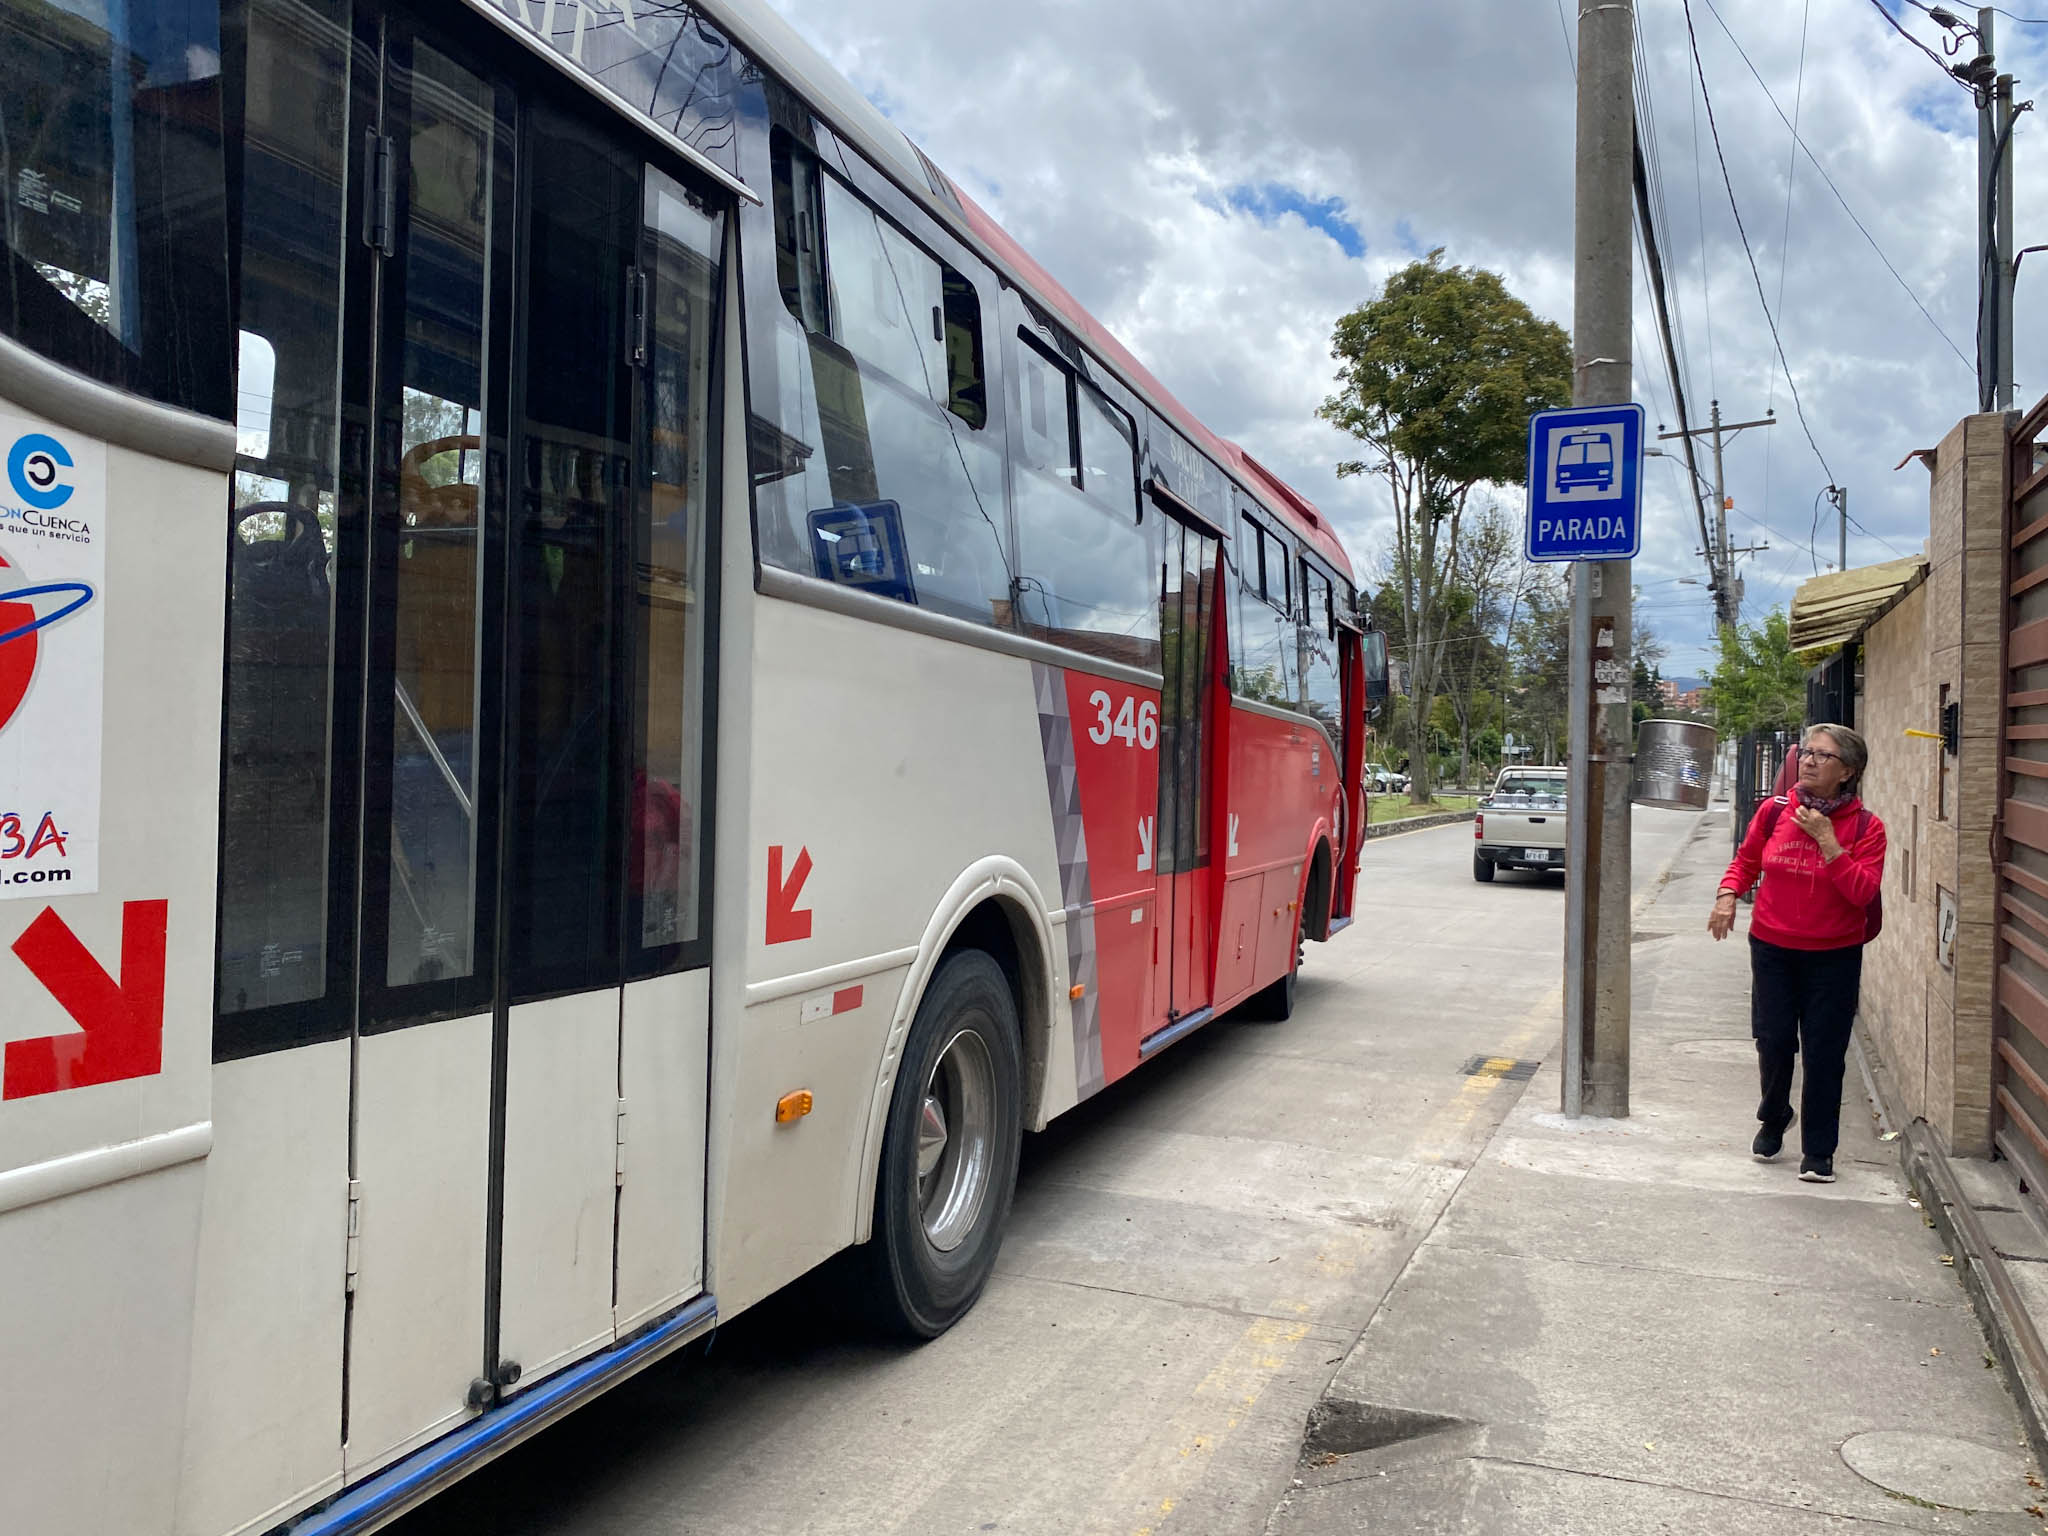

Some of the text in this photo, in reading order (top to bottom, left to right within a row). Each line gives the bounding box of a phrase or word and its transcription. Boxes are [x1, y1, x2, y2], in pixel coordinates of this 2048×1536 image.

[8, 524, 29, 534] que
[49, 531, 90, 544] servicio
[1538, 516, 1626, 542] PARADA
[1087, 690, 1158, 749] 346
